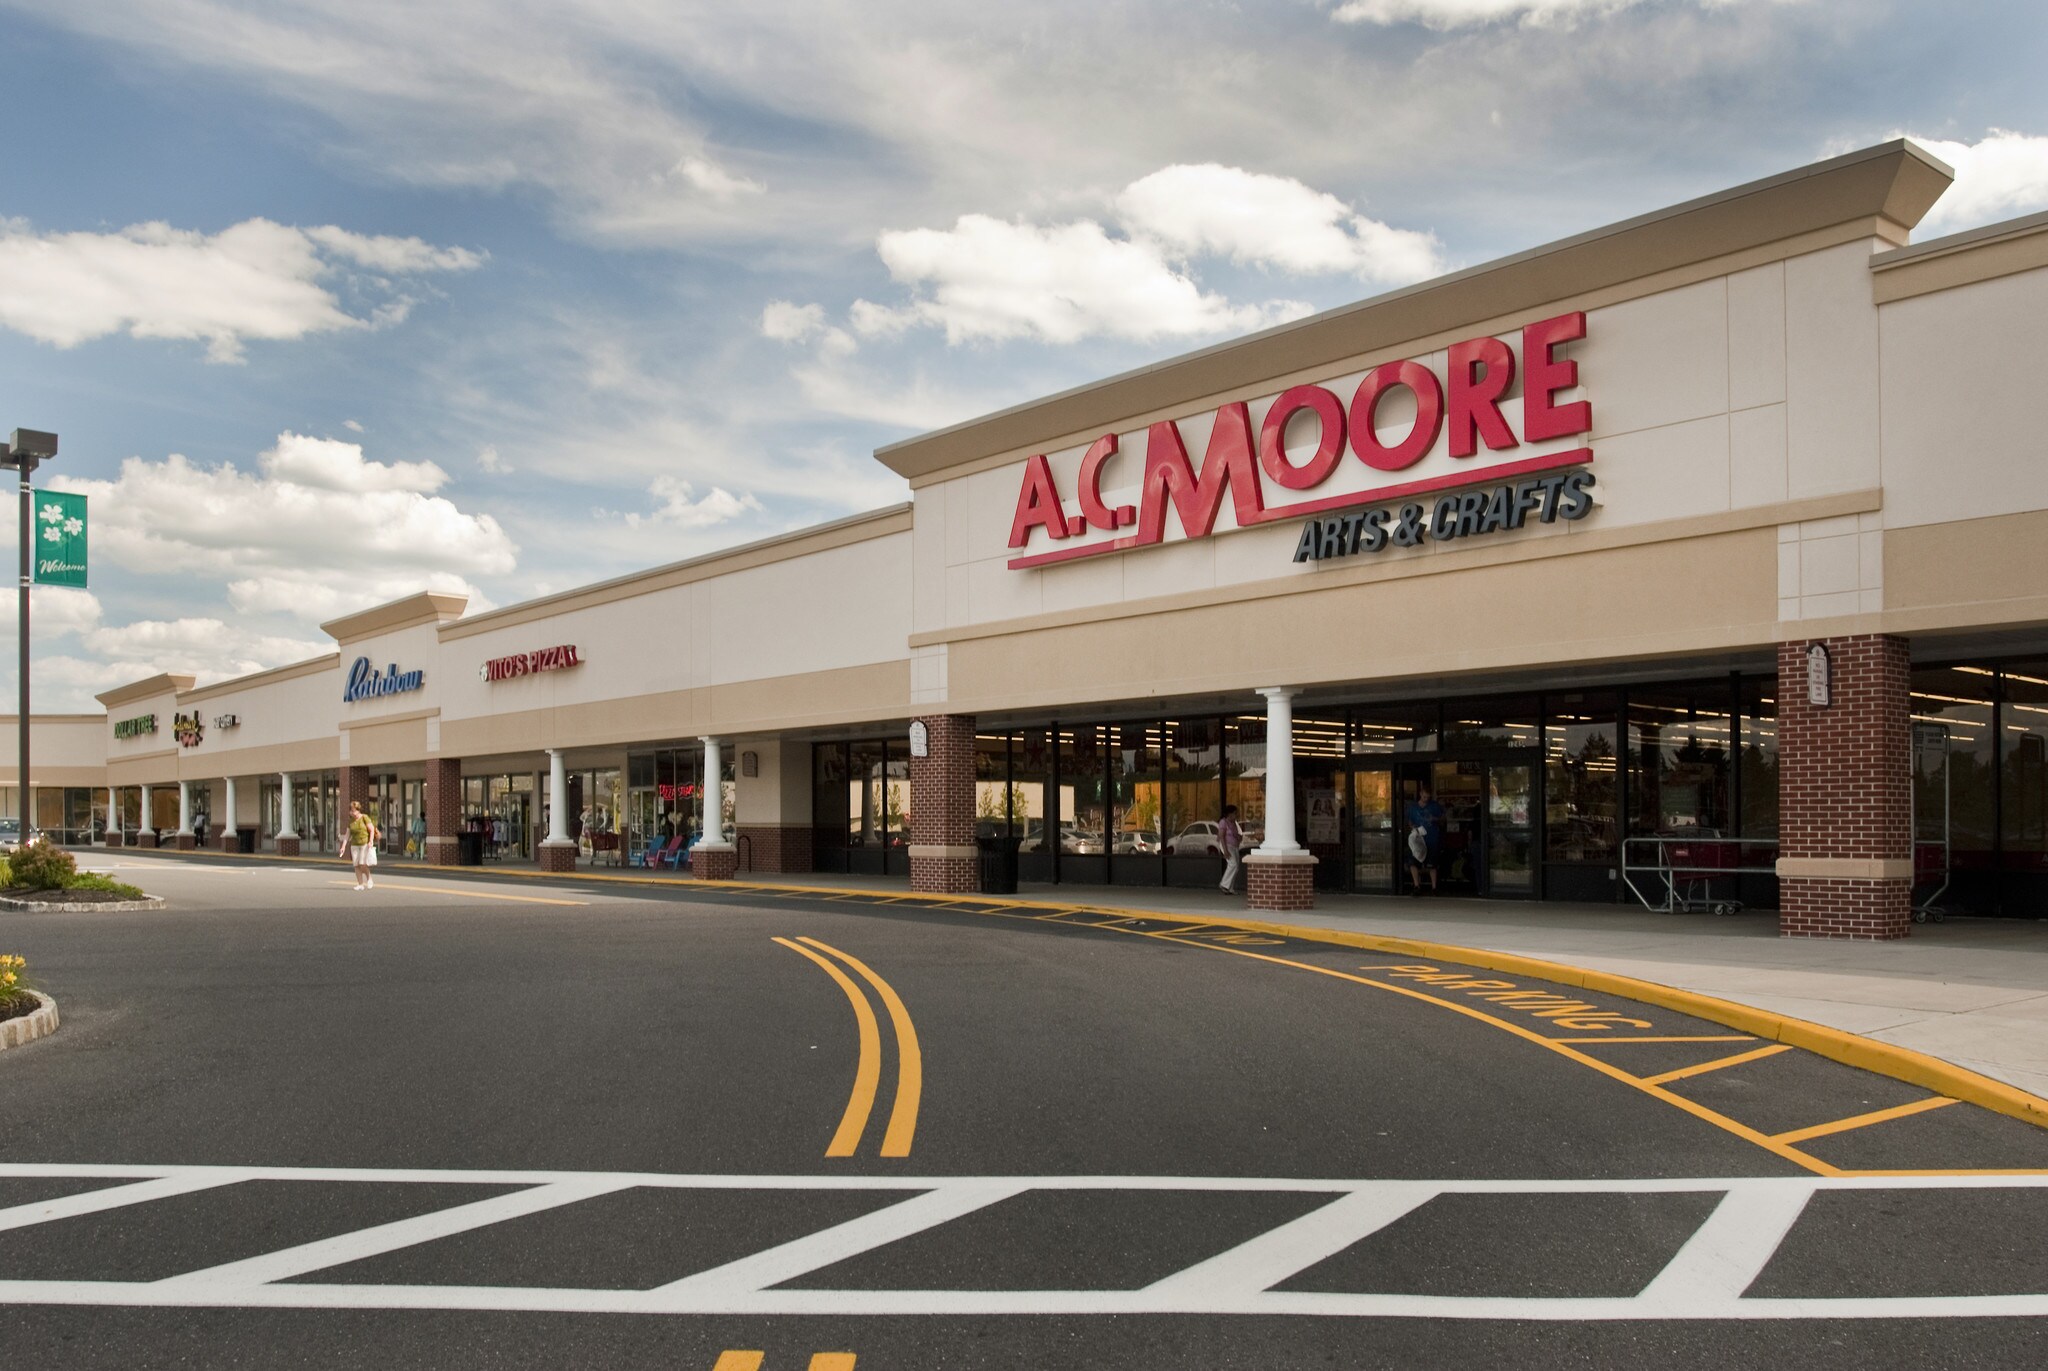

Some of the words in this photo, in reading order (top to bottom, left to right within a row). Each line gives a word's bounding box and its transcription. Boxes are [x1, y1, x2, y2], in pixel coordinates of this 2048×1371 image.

[1293, 508, 1391, 562] ARTS
[1392, 503, 1428, 548] &
[1430, 470, 1596, 541] CRAFTS
[40, 559, 86, 574] Welcome
[344, 656, 423, 702] Rainbow
[486, 654, 529, 681] VITO'S
[529, 646, 567, 673] PIZZA
[114, 719, 139, 739] DOLLAR
[139, 714, 155, 735] TREE
[1359, 965, 1652, 1029] PARKING
